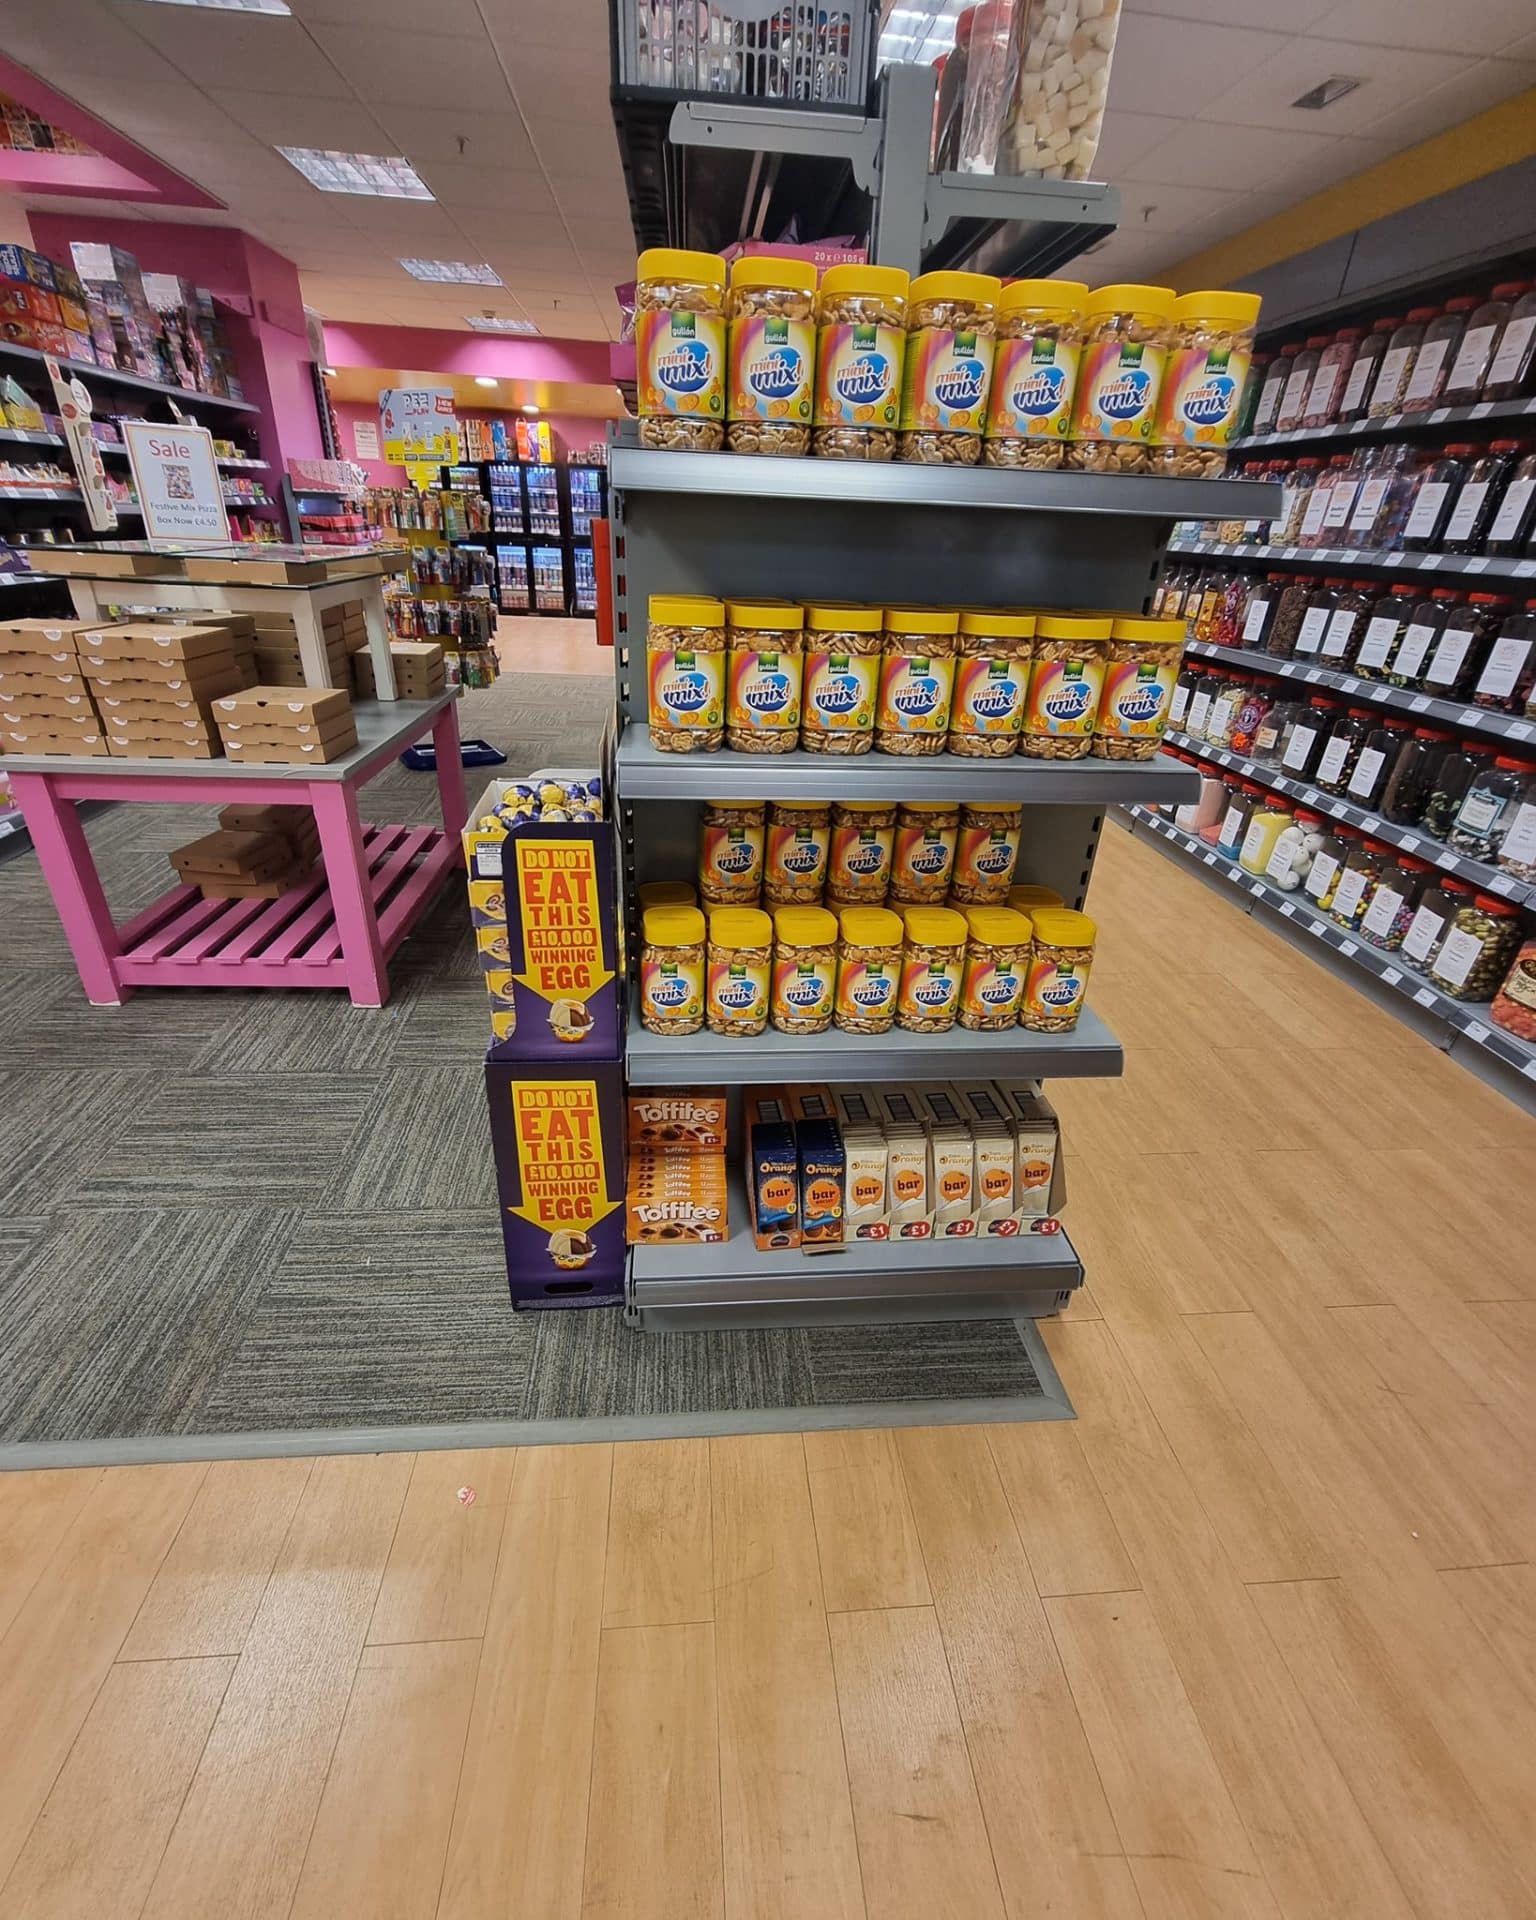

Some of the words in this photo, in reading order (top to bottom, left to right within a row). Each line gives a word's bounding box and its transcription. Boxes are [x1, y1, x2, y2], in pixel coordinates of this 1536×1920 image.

[815, 252, 825, 261] 20
[842, 254, 857, 263] 105
[657, 347, 688, 367] mini
[750, 353, 780, 373] mini
[660, 353, 712, 384] mix!
[752, 359, 803, 389] mix!
[837, 359, 868, 378] mini
[936, 365, 966, 384] mini
[839, 365, 890, 394] mix!
[937, 371, 985, 400] mix!
[1014, 372, 1044, 391] mini
[1100, 377, 1130, 395] mini
[1015, 378, 1065, 408] mix!
[1102, 382, 1150, 411] mix!
[1186, 383, 1215, 402] mini
[1188, 388, 1234, 416] mix!
[149, 440, 190, 458] Sale
[150, 502, 179, 511] Festive
[181, 503, 196, 511] Mix
[157, 516, 172, 524] Box
[195, 518, 217, 526] £4.50
[663, 677, 689, 692] mini
[667, 681, 710, 704] mix!
[745, 679, 771, 693] mini
[749, 681, 791, 705] mix!
[816, 680, 842, 695] mini
[895, 682, 921, 697] mini
[973, 685, 999, 699] mini
[819, 682, 861, 706] mix!
[898, 685, 940, 708] mix!
[976, 688, 1018, 711] mix!
[1048, 688, 1073, 702] mini
[1050, 691, 1091, 713] mix!
[1119, 690, 1146, 703] mini
[1121, 692, 1164, 714] mix!
[525, 851, 549, 868] DO
[553, 851, 588, 868] NOT
[524, 871, 592, 904] EAT
[529, 906, 591, 926] THIS
[532, 930, 593, 947] £10,000
[531, 949, 596, 964] WINNING
[540, 965, 591, 990] EGG
[522, 1091, 548, 1107] DO
[552, 1090, 589, 1106] NOT
[633, 1102, 720, 1123] Toffifee
[520, 1109, 594, 1141] EAT
[526, 1141, 593, 1161] THIS
[529, 1164, 595, 1180] £10,000
[760, 1162, 796, 1174] Orange
[806, 1164, 843, 1176] Orange
[1024, 1168, 1048, 1178] bar
[528, 1182, 598, 1197] WINNING
[767, 1187, 791, 1198] bar
[856, 1185, 879, 1196] bar
[897, 1179, 920, 1190] bar
[944, 1180, 967, 1191] bar
[985, 1178, 1008, 1189] bar
[812, 1189, 836, 1200] bar
[539, 1197, 593, 1221] EGG
[632, 1201, 721, 1223] Toffifee
[870, 1226, 885, 1237] £1
[912, 1225, 926, 1234] £1
[956, 1223, 971, 1233] £1
[1041, 1222, 1055, 1231] £1
